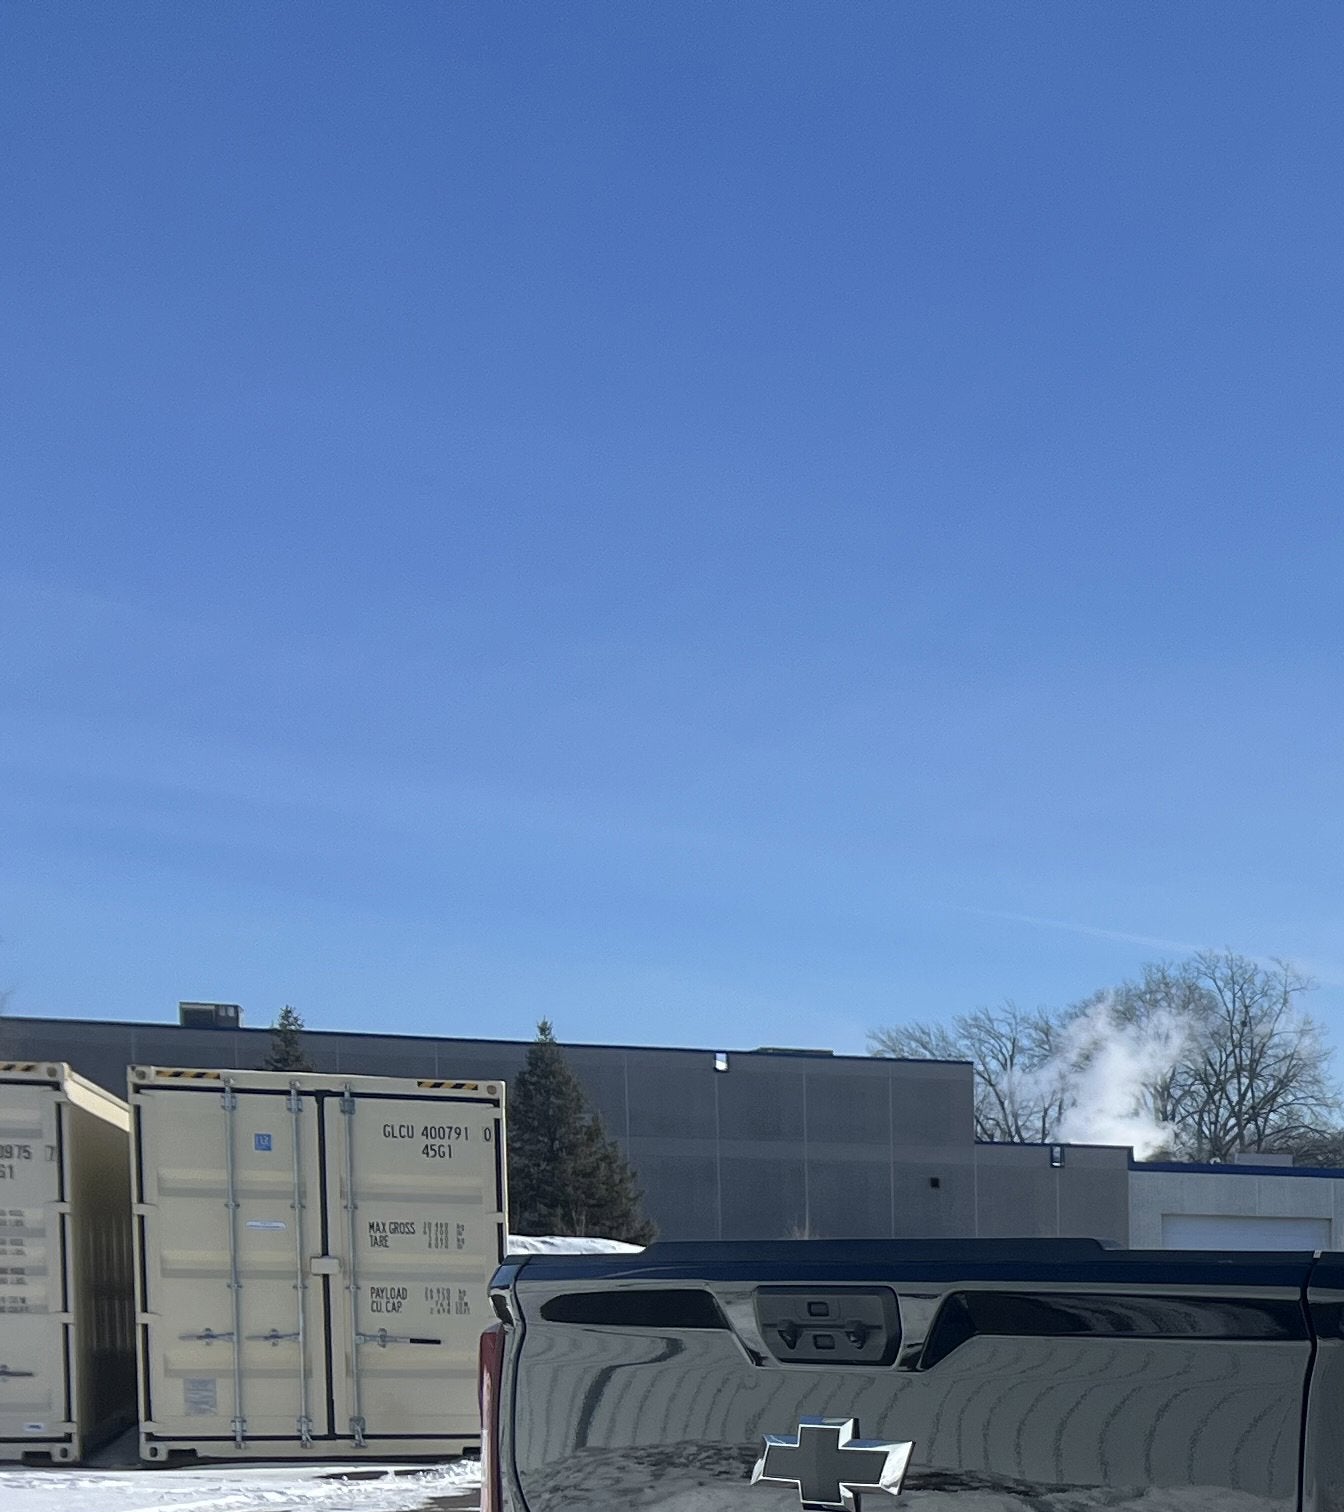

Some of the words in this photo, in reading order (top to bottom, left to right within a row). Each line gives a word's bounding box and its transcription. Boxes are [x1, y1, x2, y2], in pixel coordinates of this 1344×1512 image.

[383, 1124, 414, 1138] GLCU
[421, 1126, 468, 1140] 400791
[484, 1127, 492, 1141] 0
[421, 1144, 452, 1158] 45G1
[369, 1222, 386, 1233] MAX
[389, 1222, 416, 1235] GROSS
[370, 1235, 389, 1248] TARE
[370, 1287, 408, 1300] PAYLOAD
